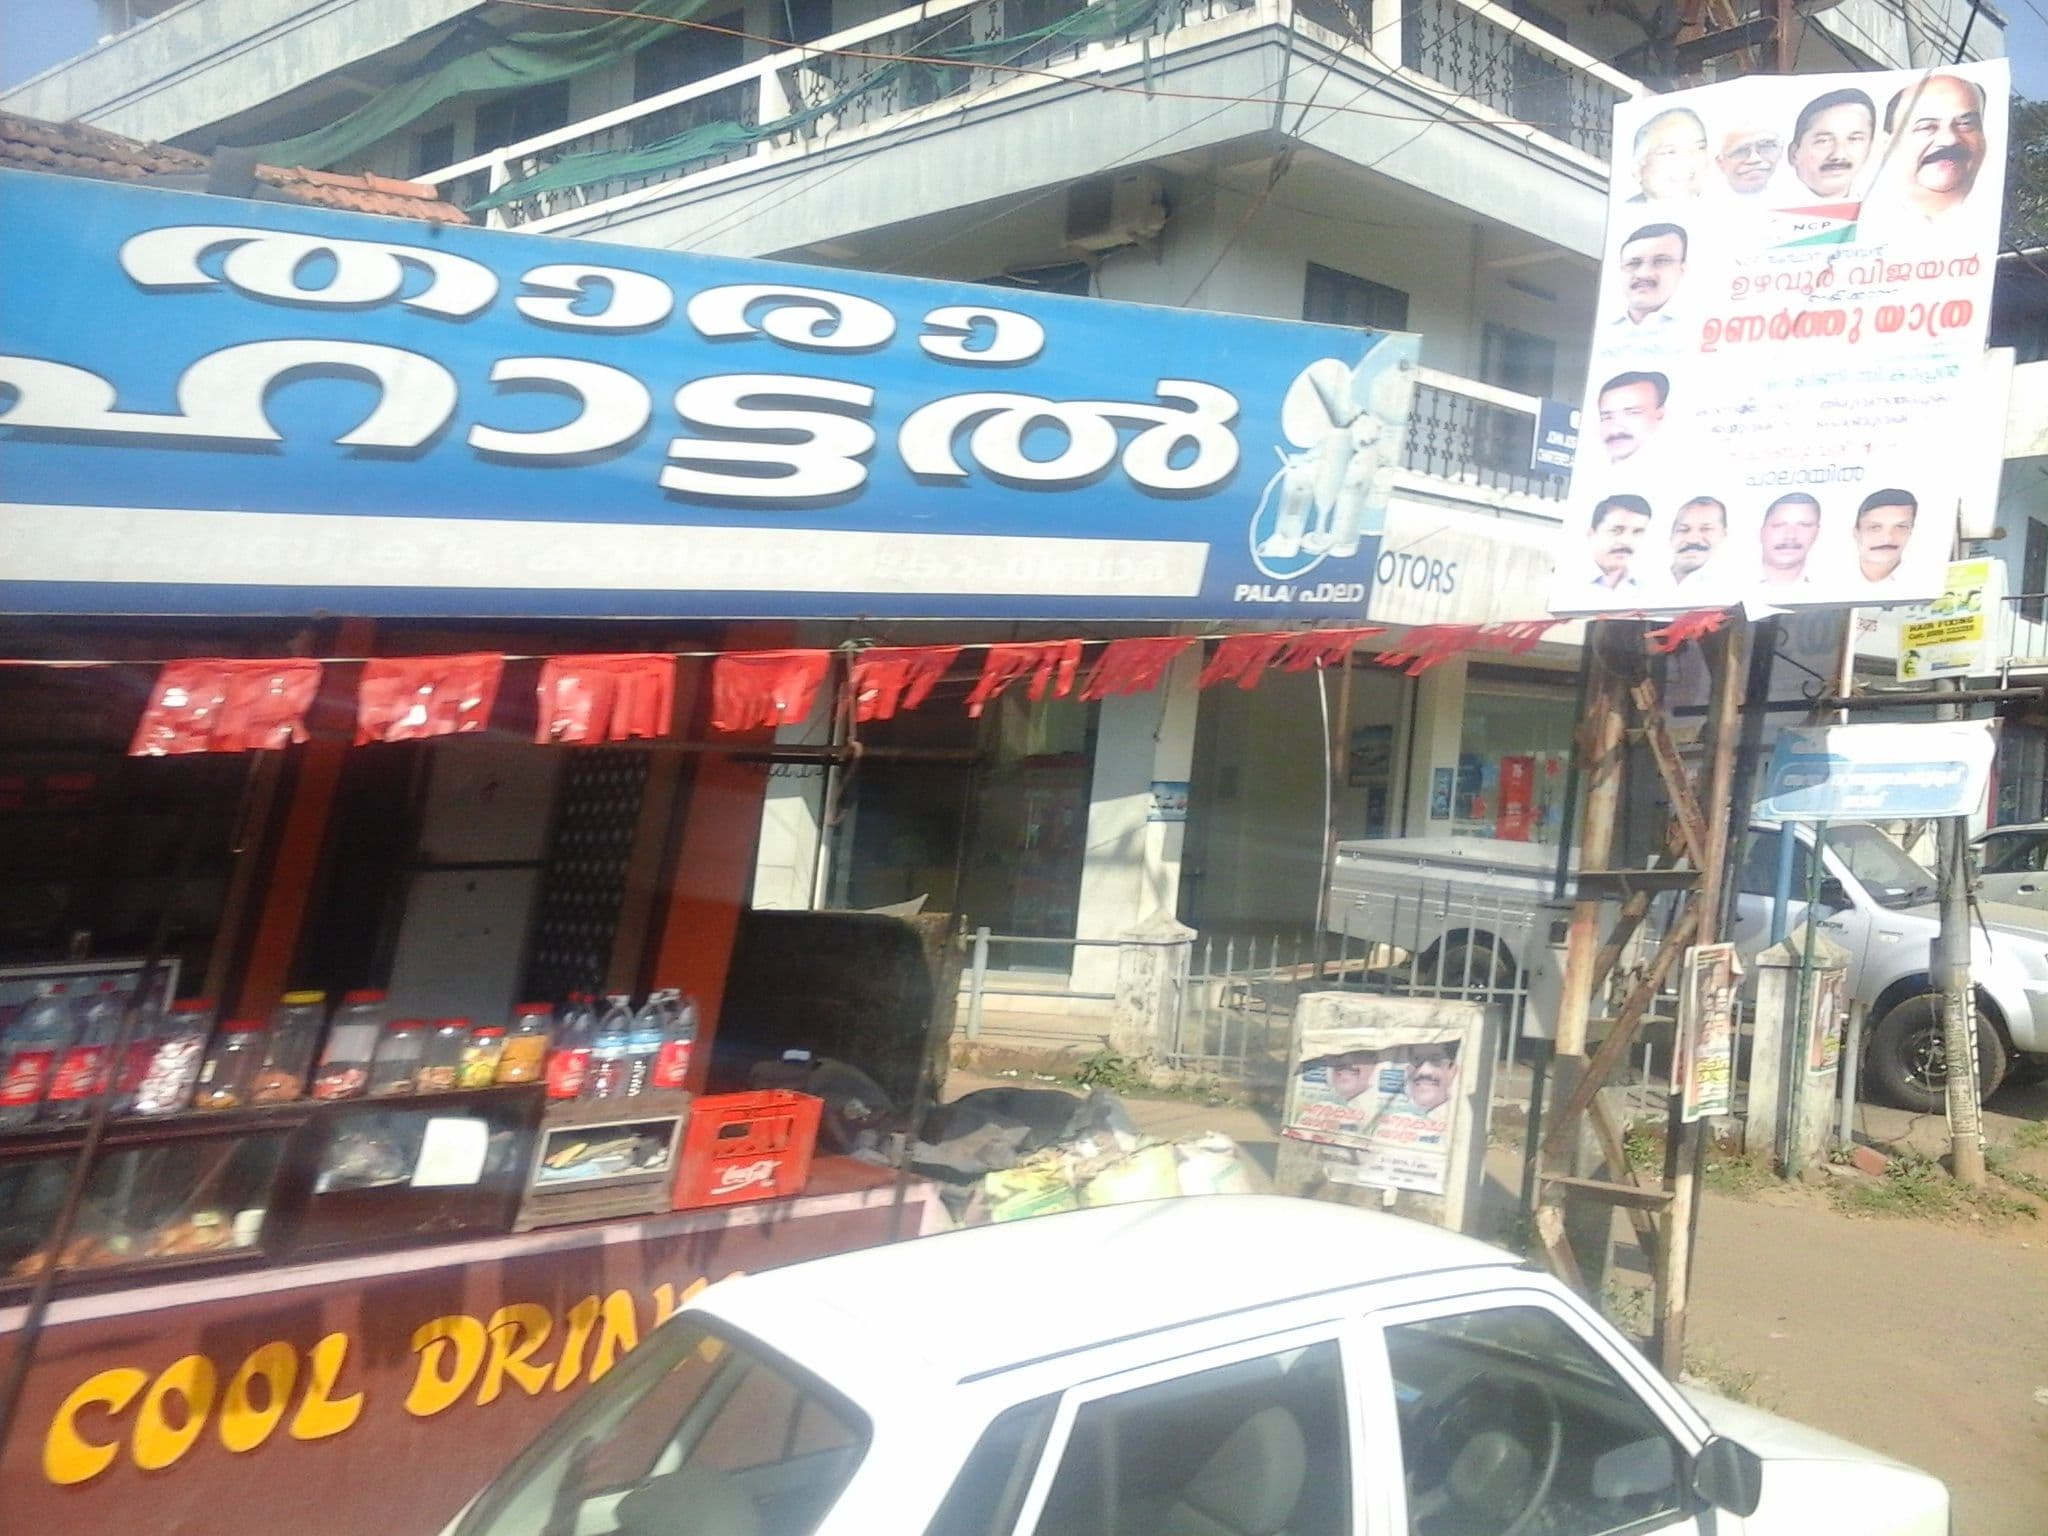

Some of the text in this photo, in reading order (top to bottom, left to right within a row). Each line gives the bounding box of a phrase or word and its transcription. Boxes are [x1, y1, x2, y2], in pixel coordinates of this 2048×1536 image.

[1793, 221, 1832, 232] NCP
[121, 226, 1044, 361] താരാ
[1849, 253, 1980, 287] വിജയൻ
[41, 1270, 748, 1485] COOL DRIN
